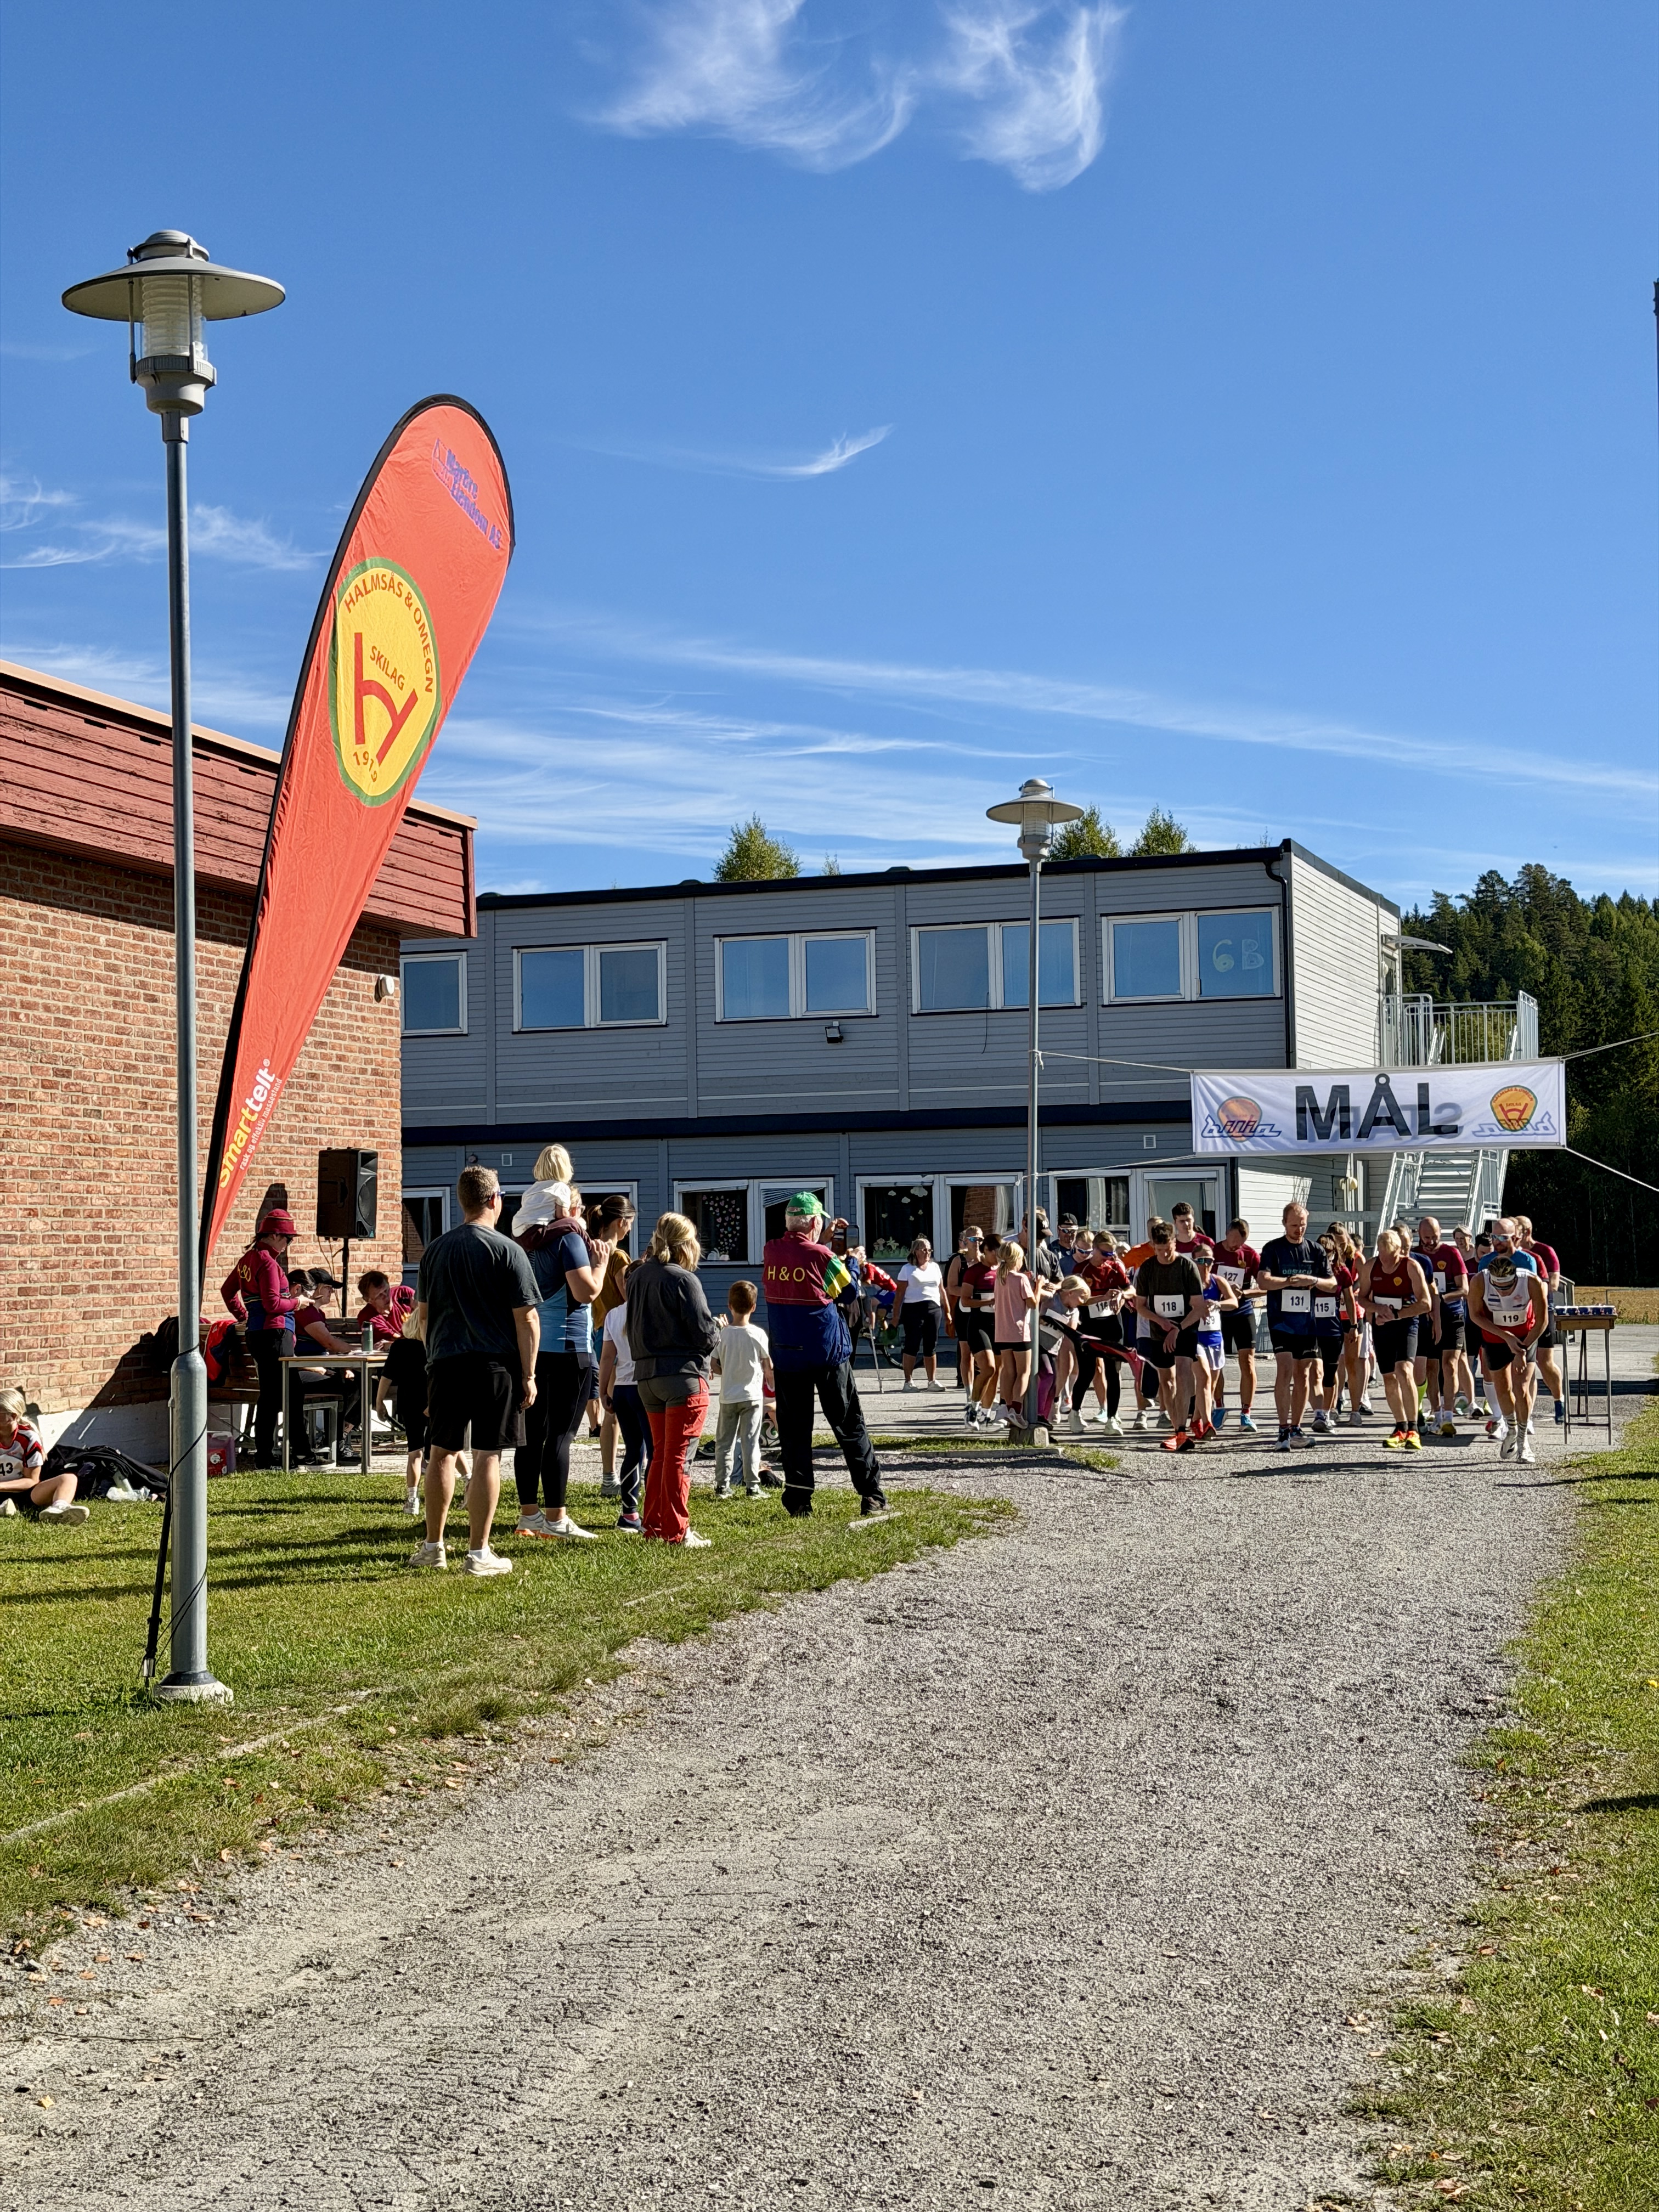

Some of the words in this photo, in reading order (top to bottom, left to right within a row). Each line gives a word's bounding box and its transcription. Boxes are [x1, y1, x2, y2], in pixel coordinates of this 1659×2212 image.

[344, 571, 403, 614] HALMSÅS
[404, 591, 413, 611] &
[413, 607, 433, 693] OMEGN
[370, 646, 405, 691] SKILAG
[1212, 939, 1265, 973] 6B
[1295, 1073, 1458, 1141] MÅL
[1223, 1271, 1238, 1282] 127
[1161, 1301, 1177, 1312] 118
[1290, 1296, 1305, 1306] 131
[1315, 1302, 1329, 1312] 115
[1503, 1314, 1519, 1323] 119
